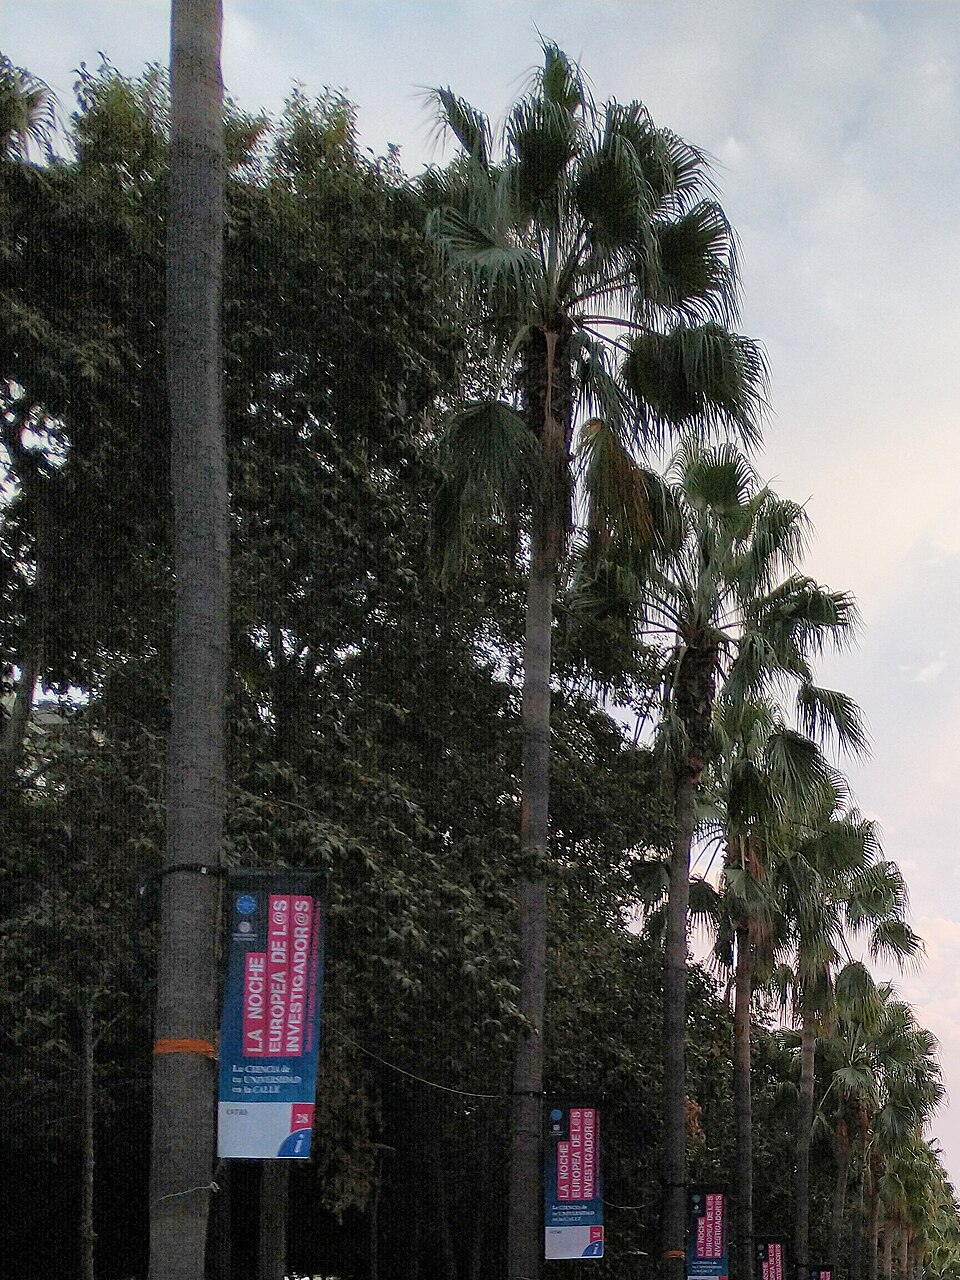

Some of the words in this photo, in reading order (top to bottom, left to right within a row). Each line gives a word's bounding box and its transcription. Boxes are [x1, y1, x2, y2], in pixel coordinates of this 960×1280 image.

[272, 900, 288, 936] L@S
[271, 940, 287, 964] DE
[247, 957, 264, 1020] NOCHE
[286, 900, 309, 1052] INVESTIGADOR@S
[268, 971, 287, 1052] EUROPEA
[247, 1029, 263, 1053] LA
[572, 1134, 581, 1147] DE
[559, 1144, 569, 1179] NOCHE
[571, 1151, 581, 1198] EUROPEA
[559, 1184, 569, 1198] LA
